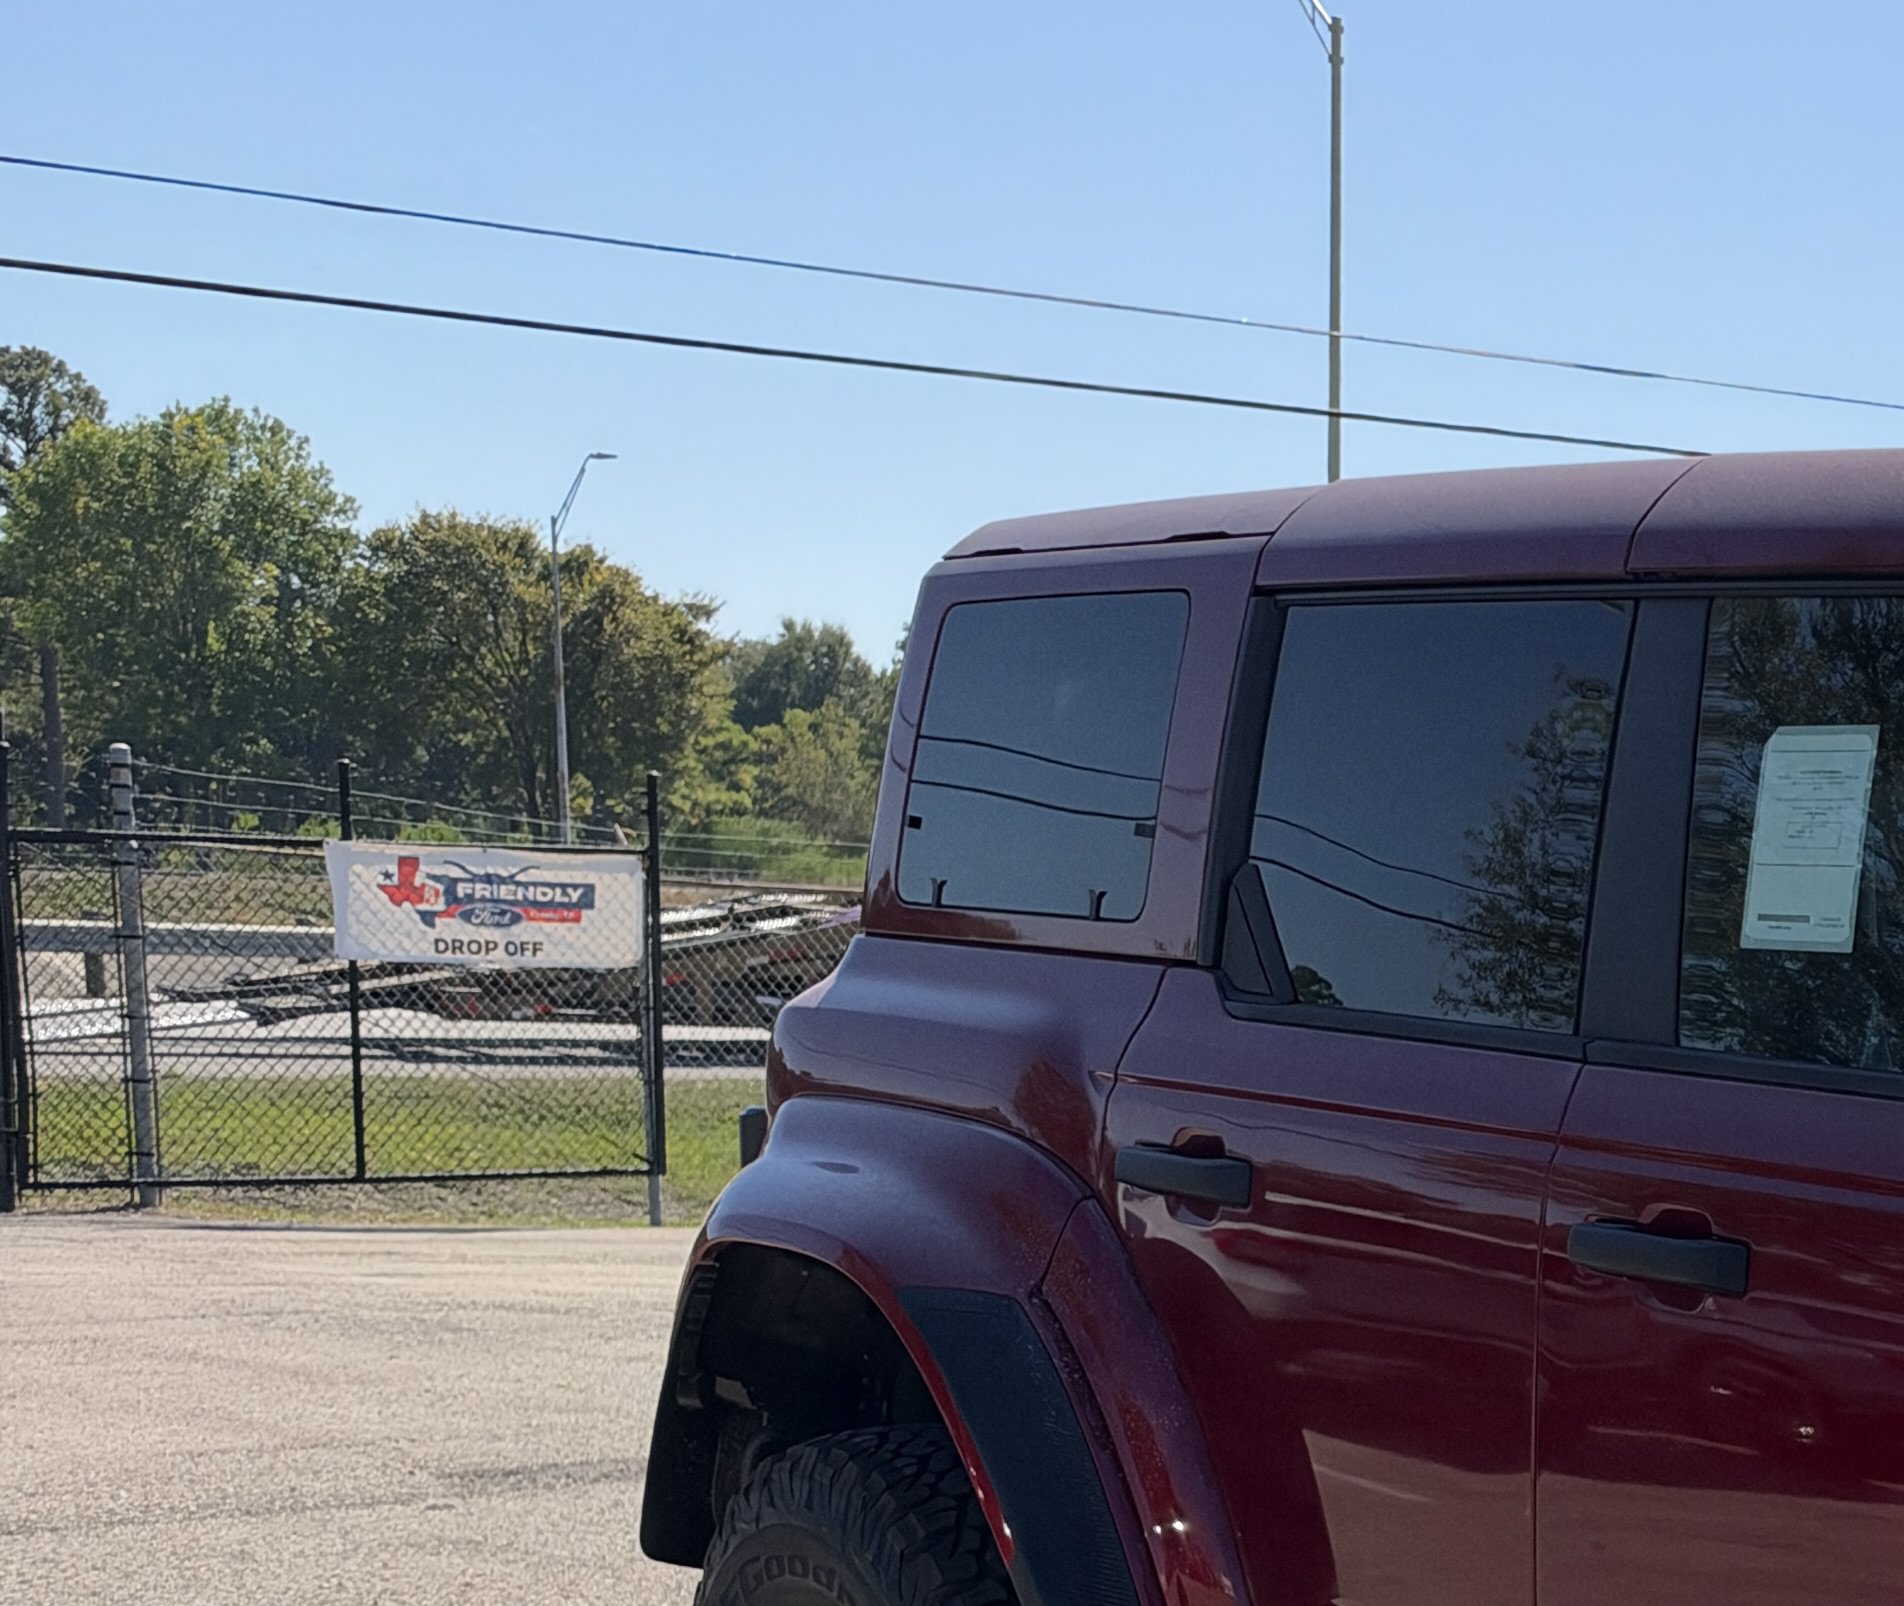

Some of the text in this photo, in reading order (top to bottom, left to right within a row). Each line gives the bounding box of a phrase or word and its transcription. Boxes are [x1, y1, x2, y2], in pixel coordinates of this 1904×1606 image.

[457, 882, 585, 904] FRIENDLY
[469, 905, 513, 926] Ford
[433, 937, 545, 958] DROP OFF
